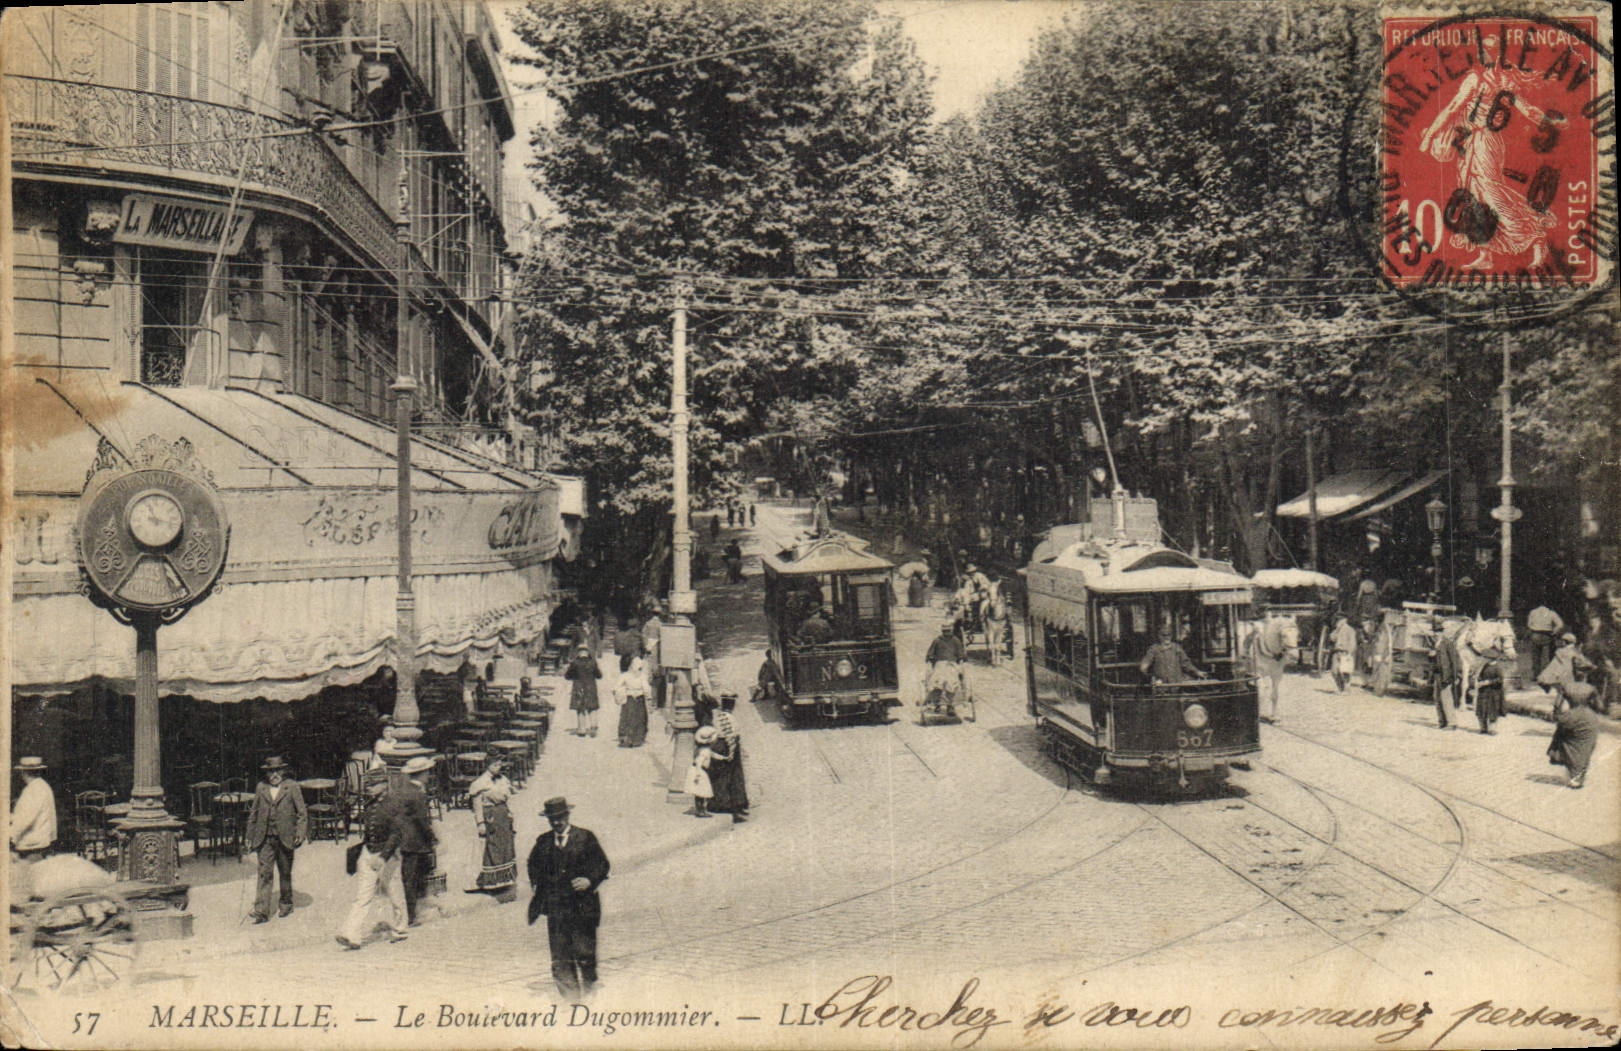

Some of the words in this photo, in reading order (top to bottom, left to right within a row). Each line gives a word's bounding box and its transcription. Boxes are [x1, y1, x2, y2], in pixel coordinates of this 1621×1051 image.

[1395, 198, 1444, 255] 10
[1567, 180, 1588, 266] POSTES
[1176, 727, 1215, 749] 567
[813, 974, 1012, 1049] Cherchez
[1080, 999, 1193, 1030] vous
